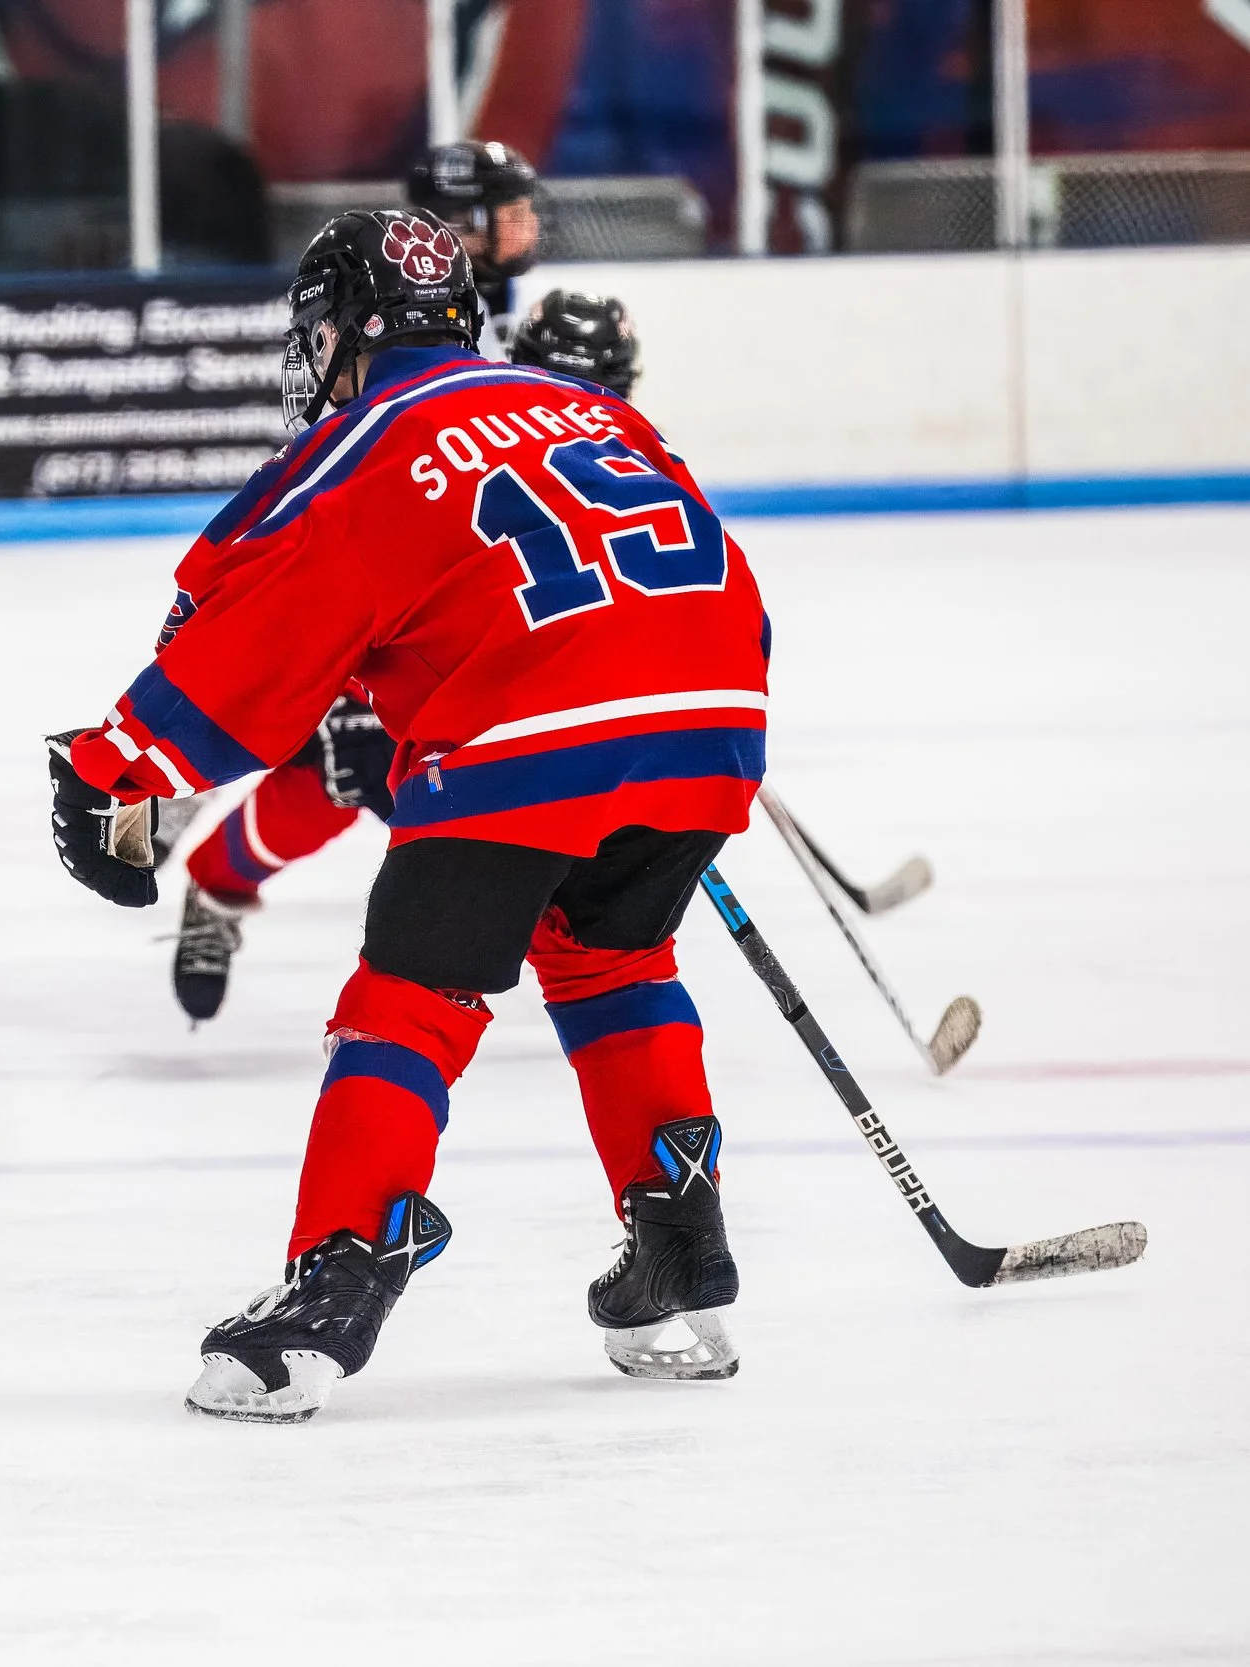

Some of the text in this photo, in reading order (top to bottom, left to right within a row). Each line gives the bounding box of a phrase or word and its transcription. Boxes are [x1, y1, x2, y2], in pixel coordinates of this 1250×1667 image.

[300, 283, 324, 301] CCM
[412, 256, 436, 275] 19
[410, 401, 624, 501] SQUIRES
[470, 433, 729, 632] 19
